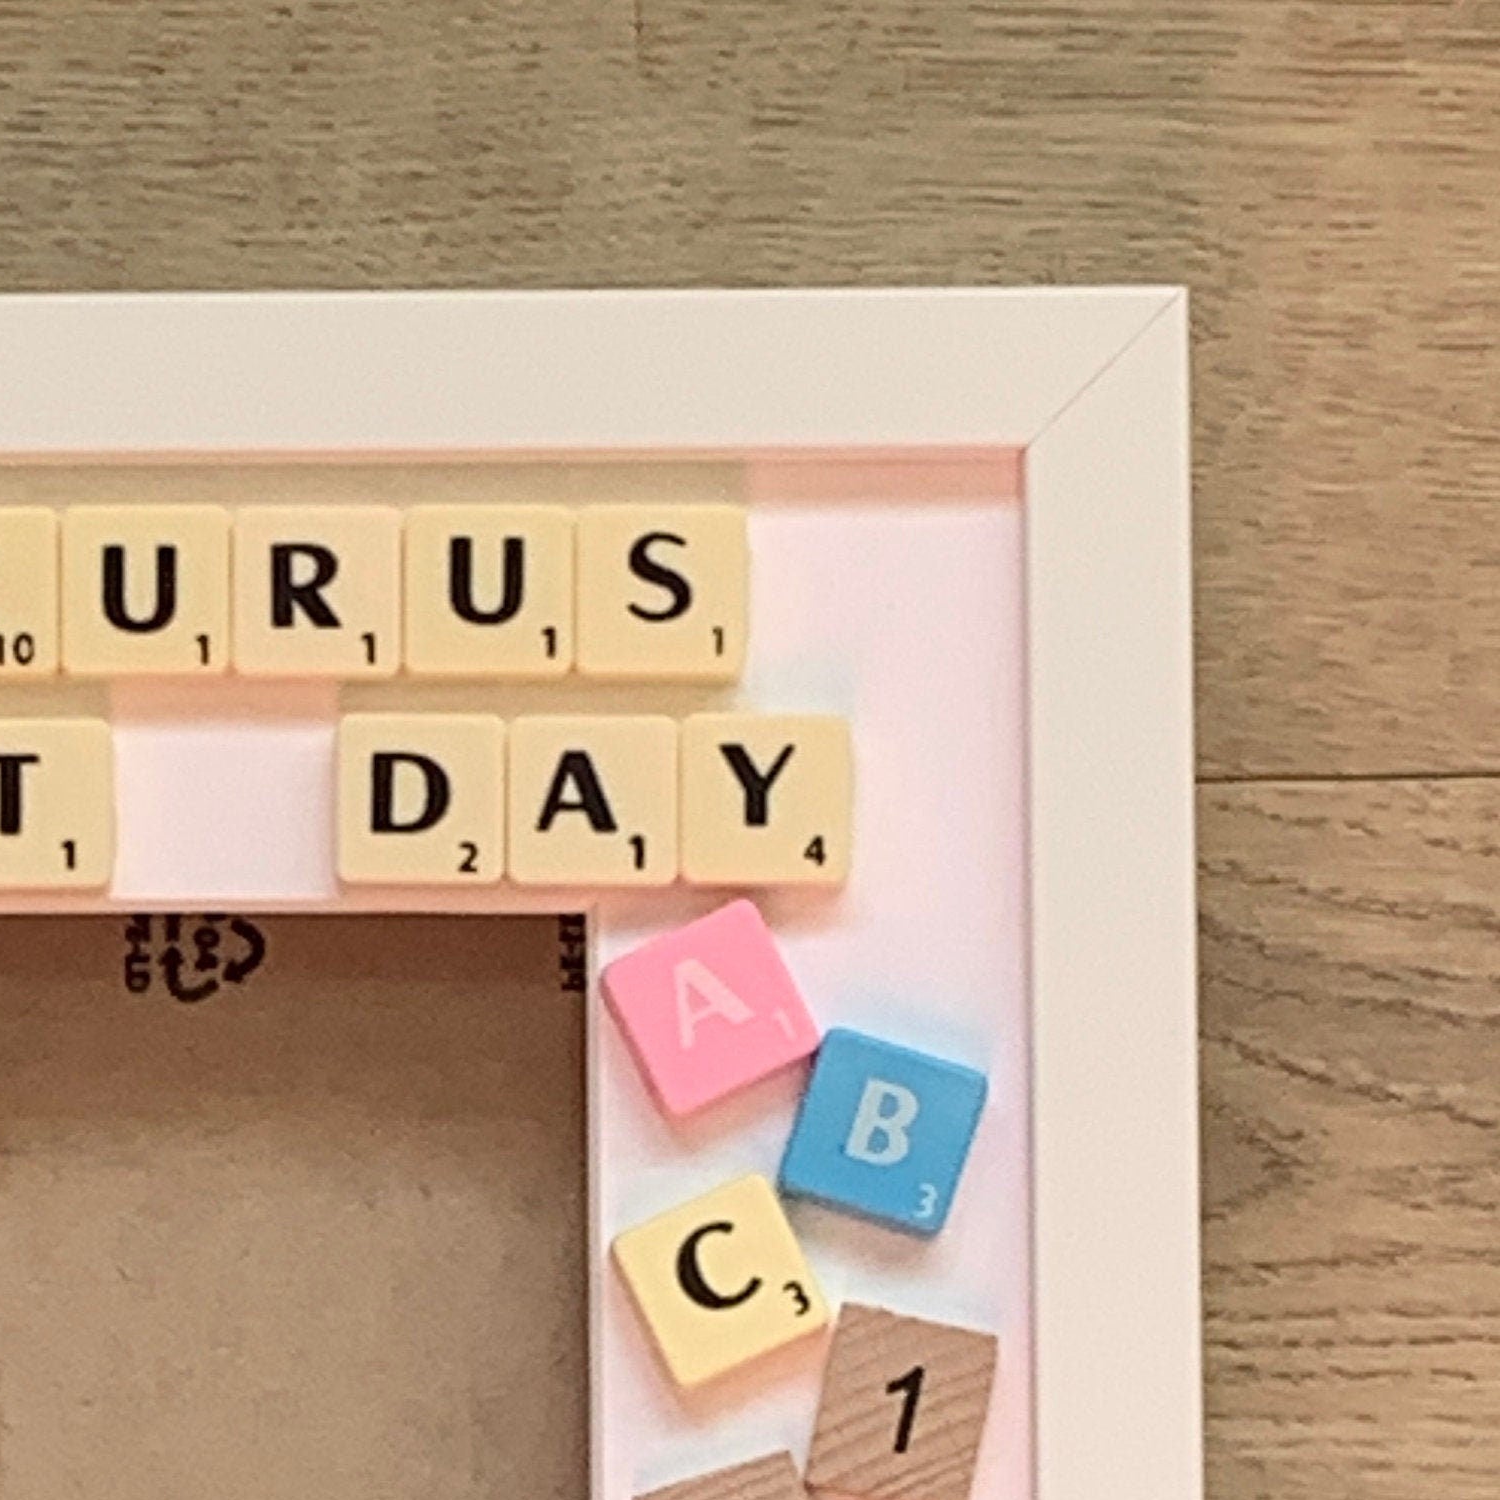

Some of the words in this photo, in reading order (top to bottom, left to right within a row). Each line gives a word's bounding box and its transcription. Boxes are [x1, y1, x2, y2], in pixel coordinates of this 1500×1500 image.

[195, 633, 210, 666] 1
[360, 631, 377, 665] 1
[541, 625, 557, 659] 1
[711, 625, 725, 657] 1
[370, 743, 795, 834] DAY
[61, 839, 77, 871] 1
[457, 840, 479, 874] 2
[628, 833, 646, 871] 1
[802, 834, 827, 867] 4
[673, 957, 754, 1050] A
[774, 1010, 797, 1042] 1
[845, 1076, 921, 1167] B
[916, 1183, 939, 1219] 3
[676, 1222, 762, 1310] C
[783, 1280, 811, 1316] 3
[886, 1365, 925, 1455] 1
